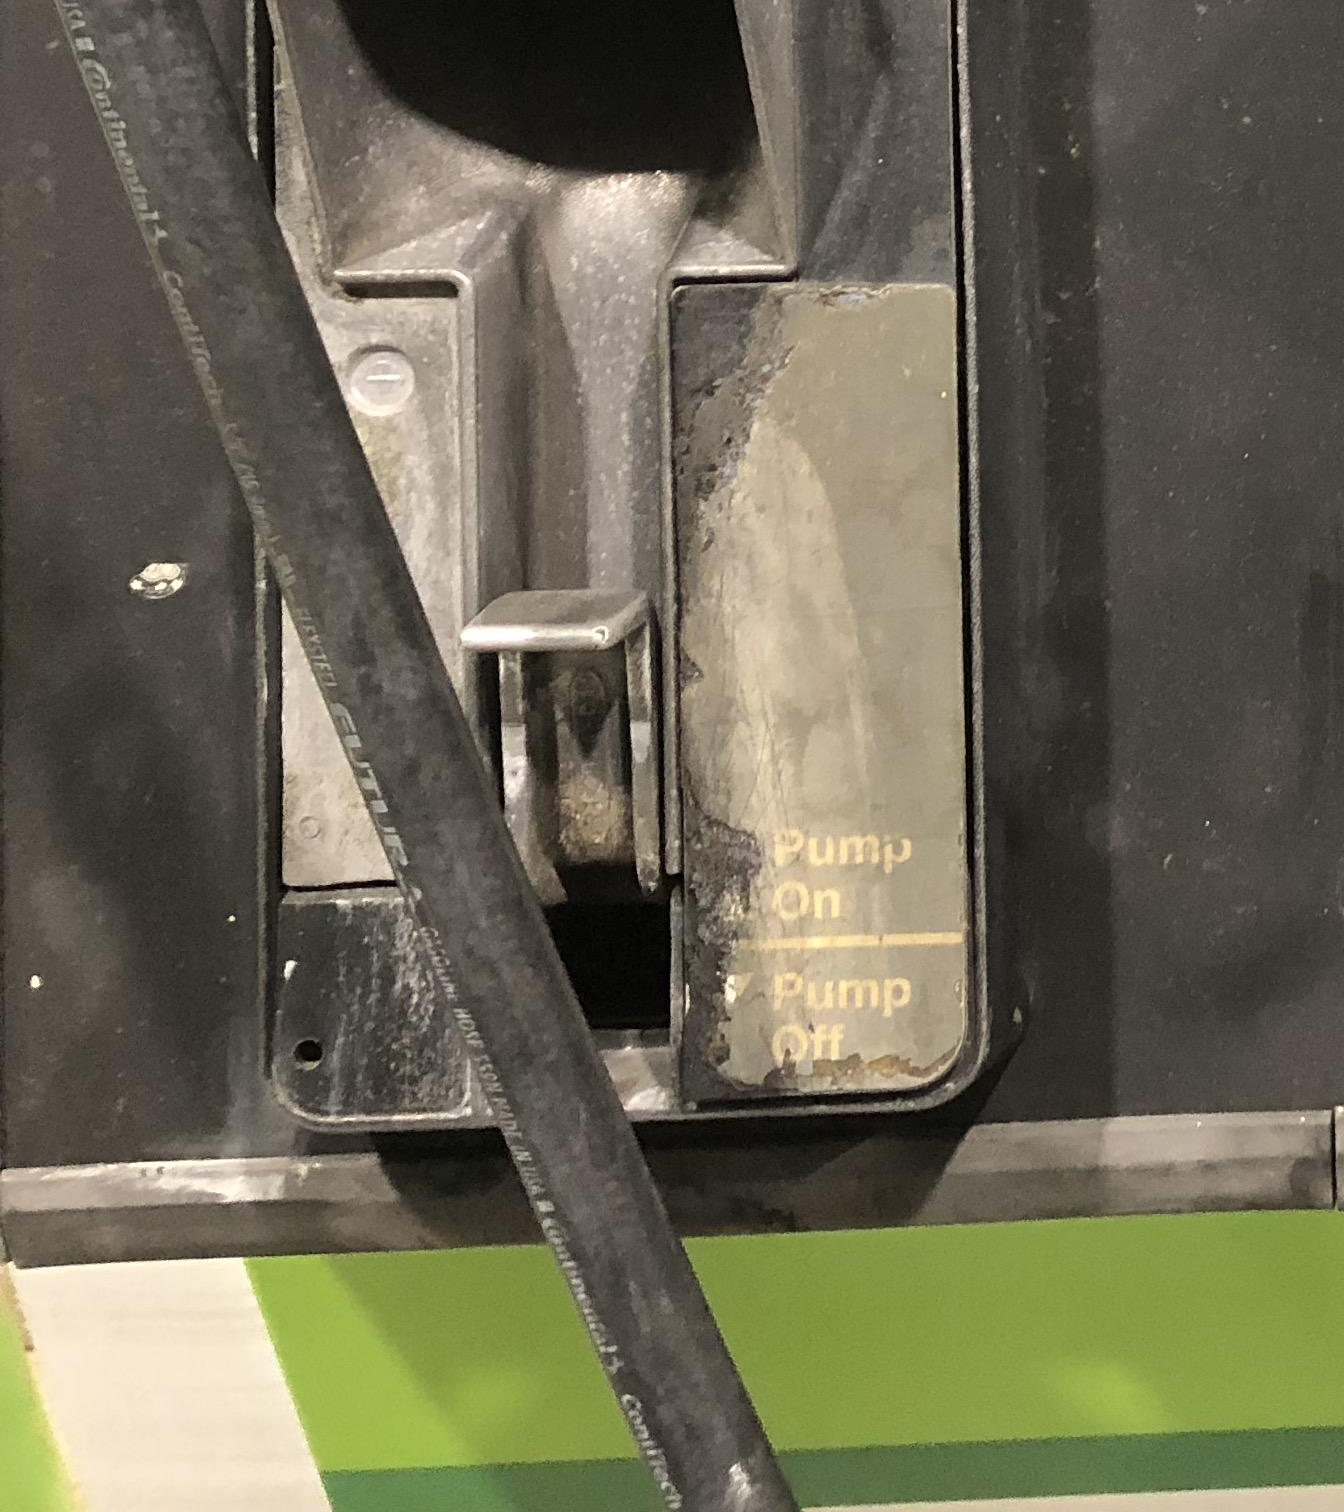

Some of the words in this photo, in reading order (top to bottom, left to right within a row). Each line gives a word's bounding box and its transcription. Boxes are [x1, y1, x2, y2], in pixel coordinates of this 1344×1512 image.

[773, 829, 912, 873] Pump
[771, 880, 841, 920] On
[773, 972, 912, 1017] Pump
[771, 1023, 844, 1068] Off
